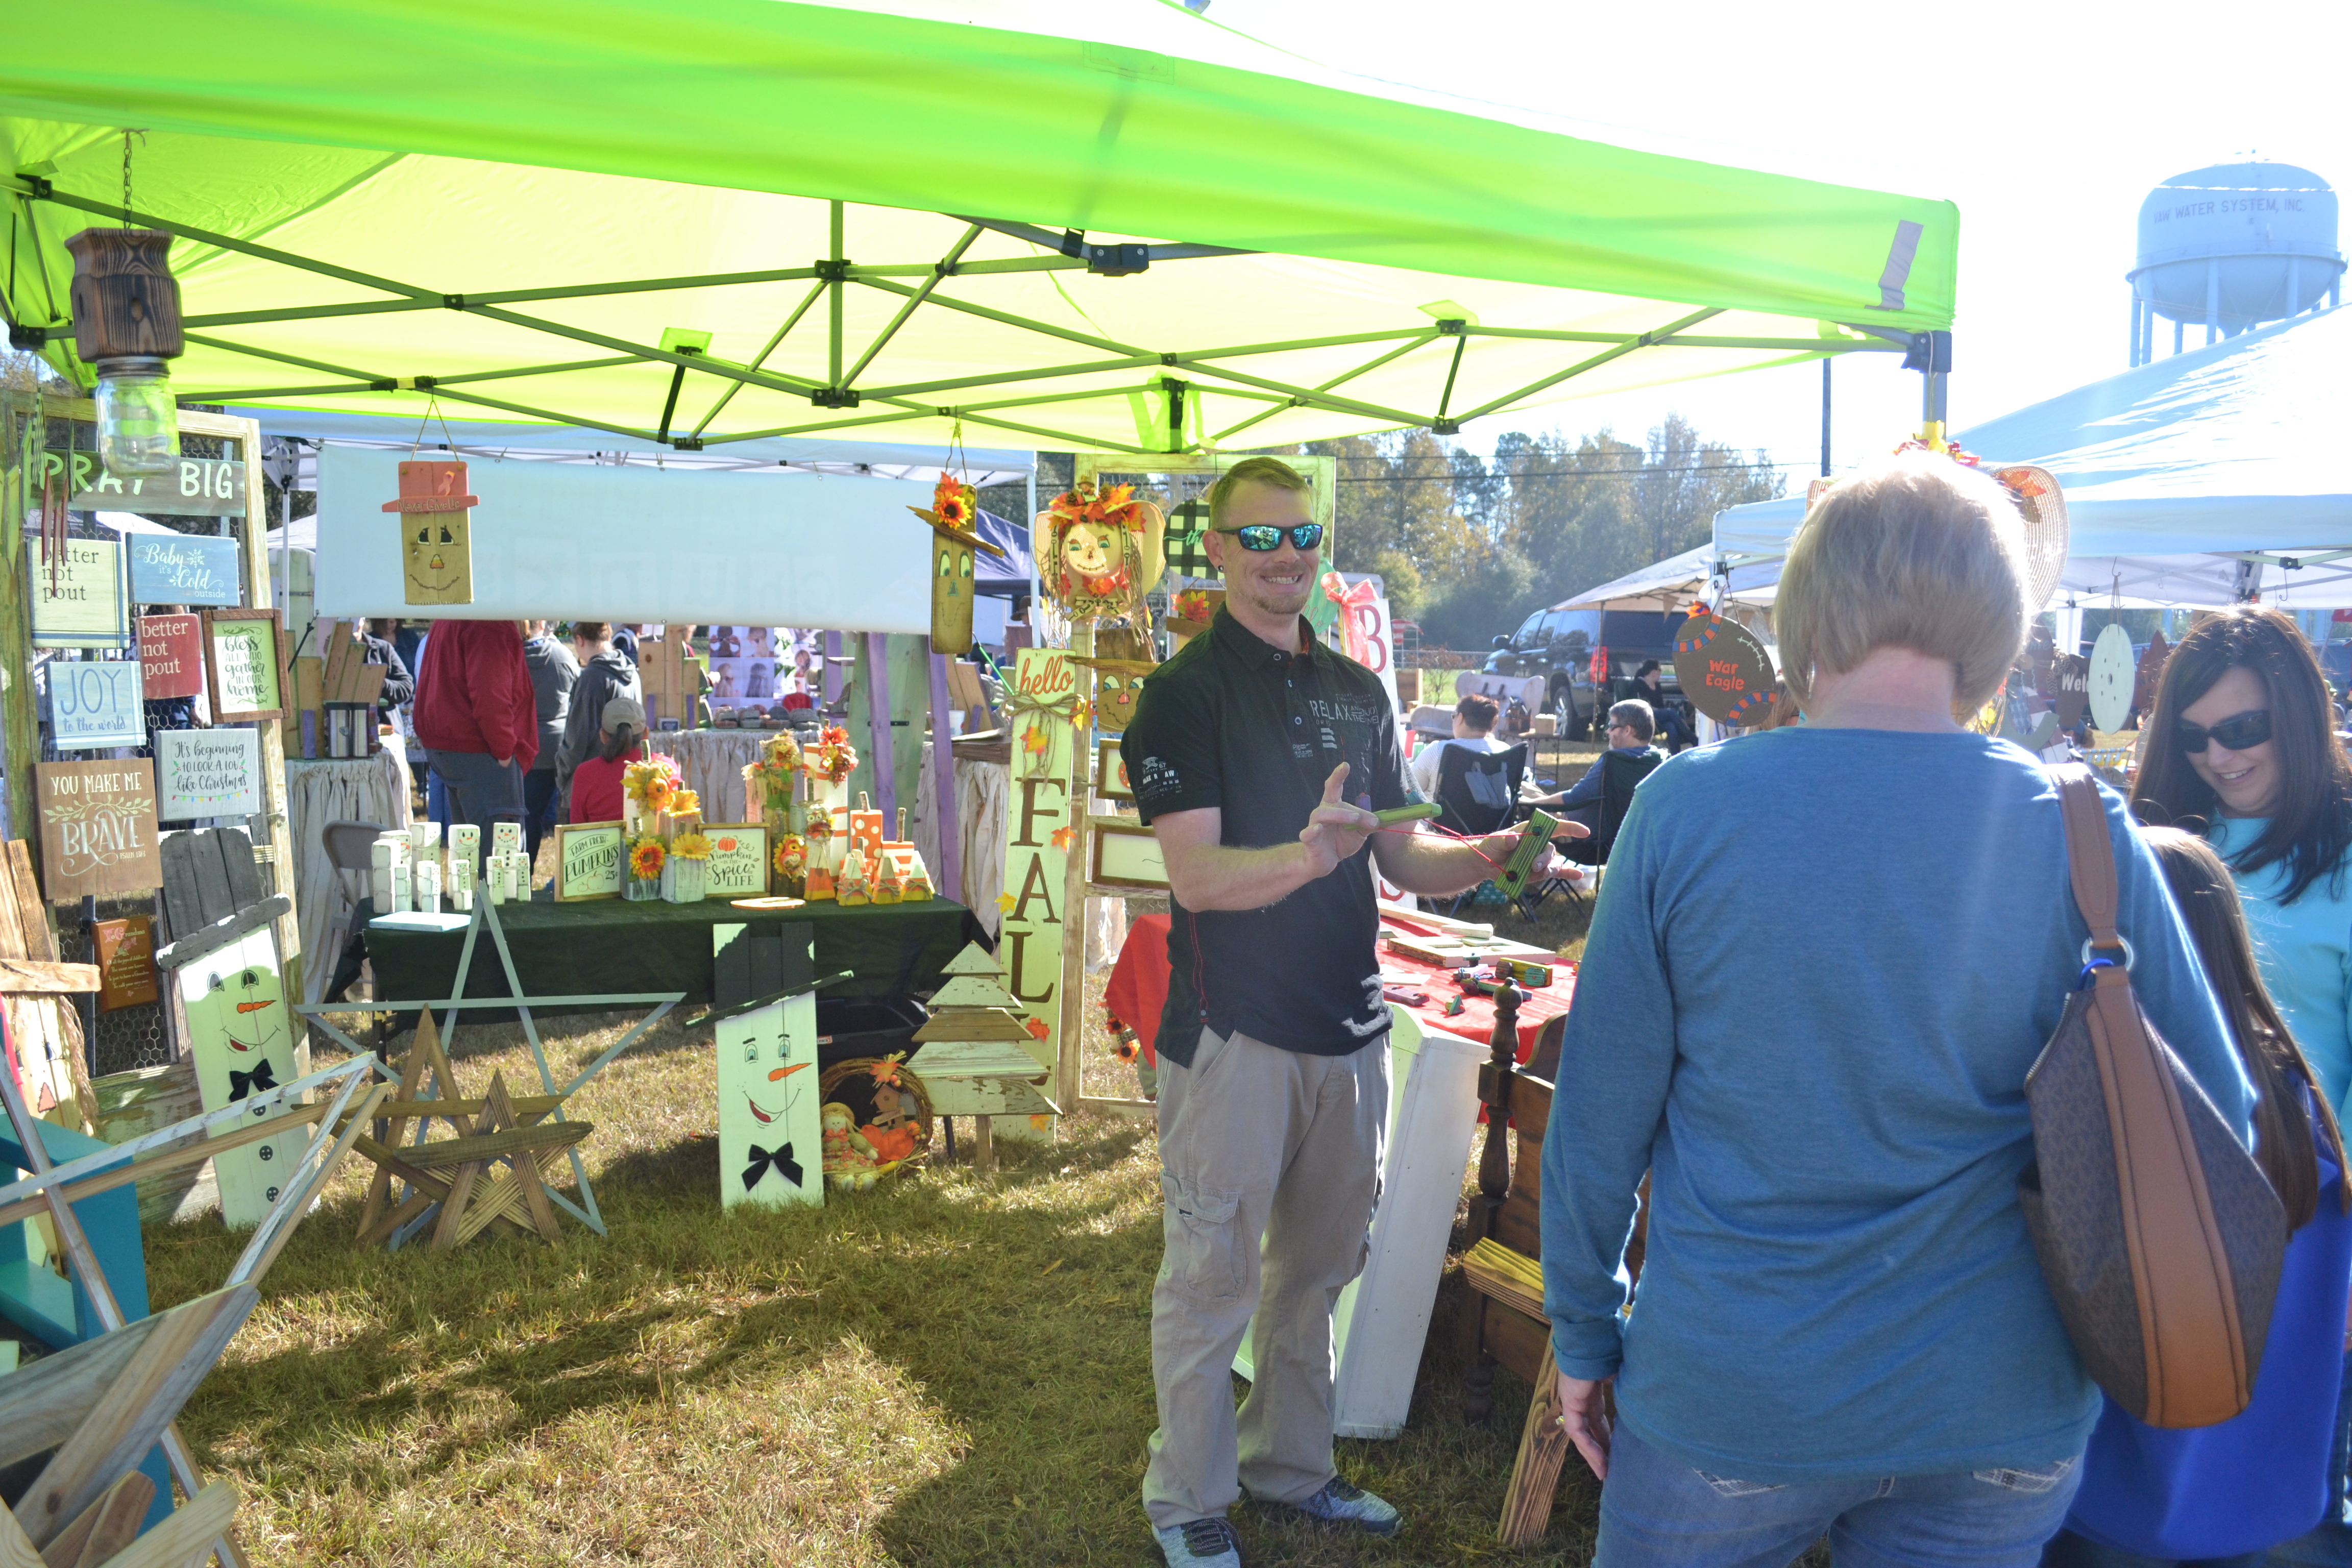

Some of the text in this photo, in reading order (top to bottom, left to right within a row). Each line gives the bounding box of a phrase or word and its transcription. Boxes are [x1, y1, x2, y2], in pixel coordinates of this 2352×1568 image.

[2175, 201, 2215, 219] WATER
[2221, 198, 2278, 214] SYSTEM,
[2284, 198, 2305, 212] INC.
[180, 461, 233, 500] BIG
[397, 497, 460, 512] Never Give Up
[134, 543, 185, 576] Baby
[42, 566, 74, 581] not
[159, 566, 172, 574] it's
[177, 569, 224, 590] Cold
[43, 585, 87, 603] pout
[194, 589, 226, 598] outside
[140, 619, 189, 638] better
[142, 641, 168, 656] not
[222, 635, 262, 653] bless
[226, 651, 262, 662] ALL WHO
[144, 657, 181, 680] pout
[225, 660, 266, 679] gather
[1019, 654, 1074, 695] hello
[1709, 659, 1739, 675] War
[227, 679, 269, 696] home
[236, 674, 262, 684] IN OUR
[1706, 673, 1745, 691] Eagle
[60, 668, 121, 716] JOY
[1309, 700, 1353, 721] RELAX
[62, 715, 127, 732] to the world
[175, 740, 244, 761] It's beginning
[193, 761, 214, 772] LOOK
[215, 760, 223, 771] A
[51, 772, 142, 795] YOU MAKE ME
[175, 773, 247, 792] like Christmas
[60, 809, 145, 875] BRAVE
[571, 835, 606, 856] FARM FRESH
[709, 846, 752, 861] Pumpkin
[565, 845, 619, 883] PUMPKINS
[712, 863, 750, 886] Spice
[726, 875, 754, 887] LIFE
[102, 927, 145, 943] To Grandma
